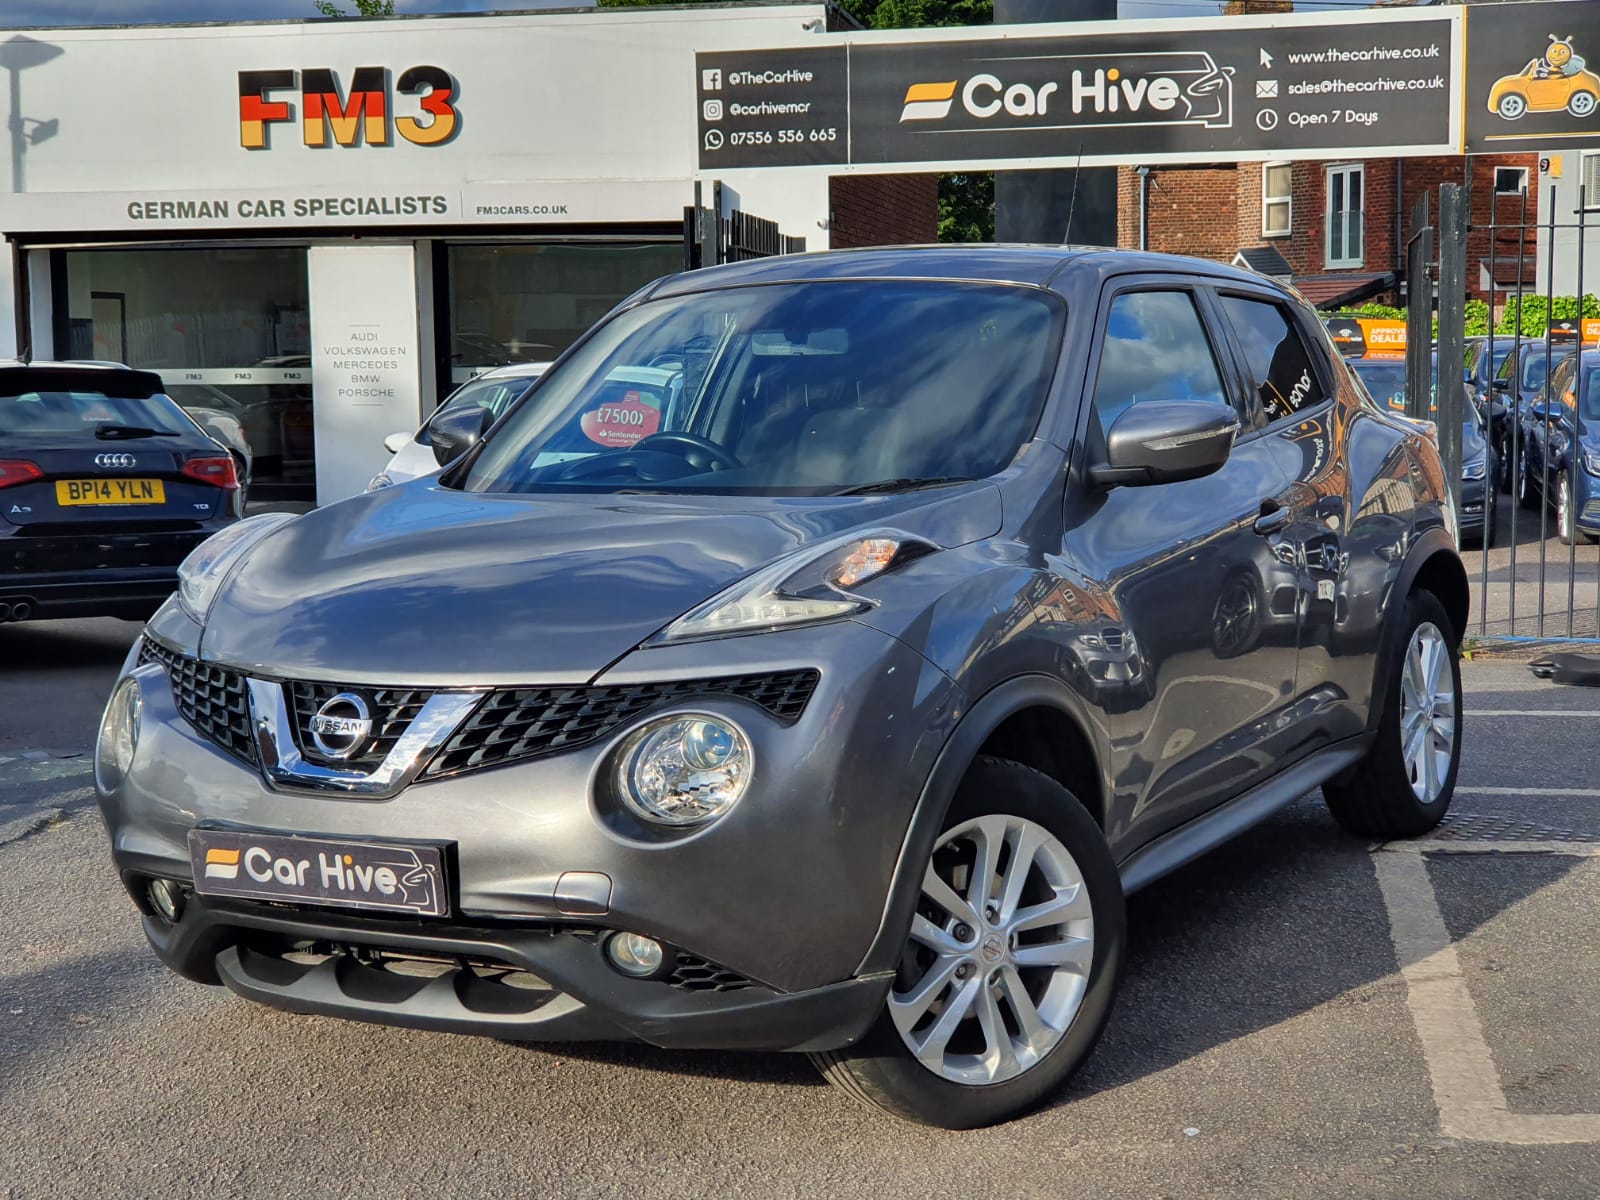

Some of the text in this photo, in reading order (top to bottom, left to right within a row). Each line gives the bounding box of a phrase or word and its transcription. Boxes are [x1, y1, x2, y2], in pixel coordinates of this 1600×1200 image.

[1288, 43, 1439, 64] www.thecarhive.co.uk
[728, 69, 813, 85] @TheCarHive
[1288, 74, 1444, 95] sales@thecarhive.co.uk
[962, 68, 1180, 118] Car Hive
[238, 65, 456, 147] FM3
[729, 101, 811, 116] @carhivemcr
[1288, 110, 1378, 128] Open 7 Days
[730, 128, 837, 145] 07556 556 665
[127, 196, 448, 220] GERMAN CAR SPECIALISTS
[476, 205, 568, 215] FM3CARS.CO.UK
[350, 332, 378, 341] AUDI
[1370, 334, 1406, 343] DEALE
[323, 346, 406, 355] VOLKSWAGEN
[333, 360, 398, 369] MERCEDES
[283, 372, 301, 380] FM3
[351, 374, 380, 383] BMW
[338, 388, 395, 397] PORSCHE
[68, 481, 153, 500] BP14 YLN
[311, 718, 362, 732] NISSAN
[243, 846, 398, 895] Car Hive
